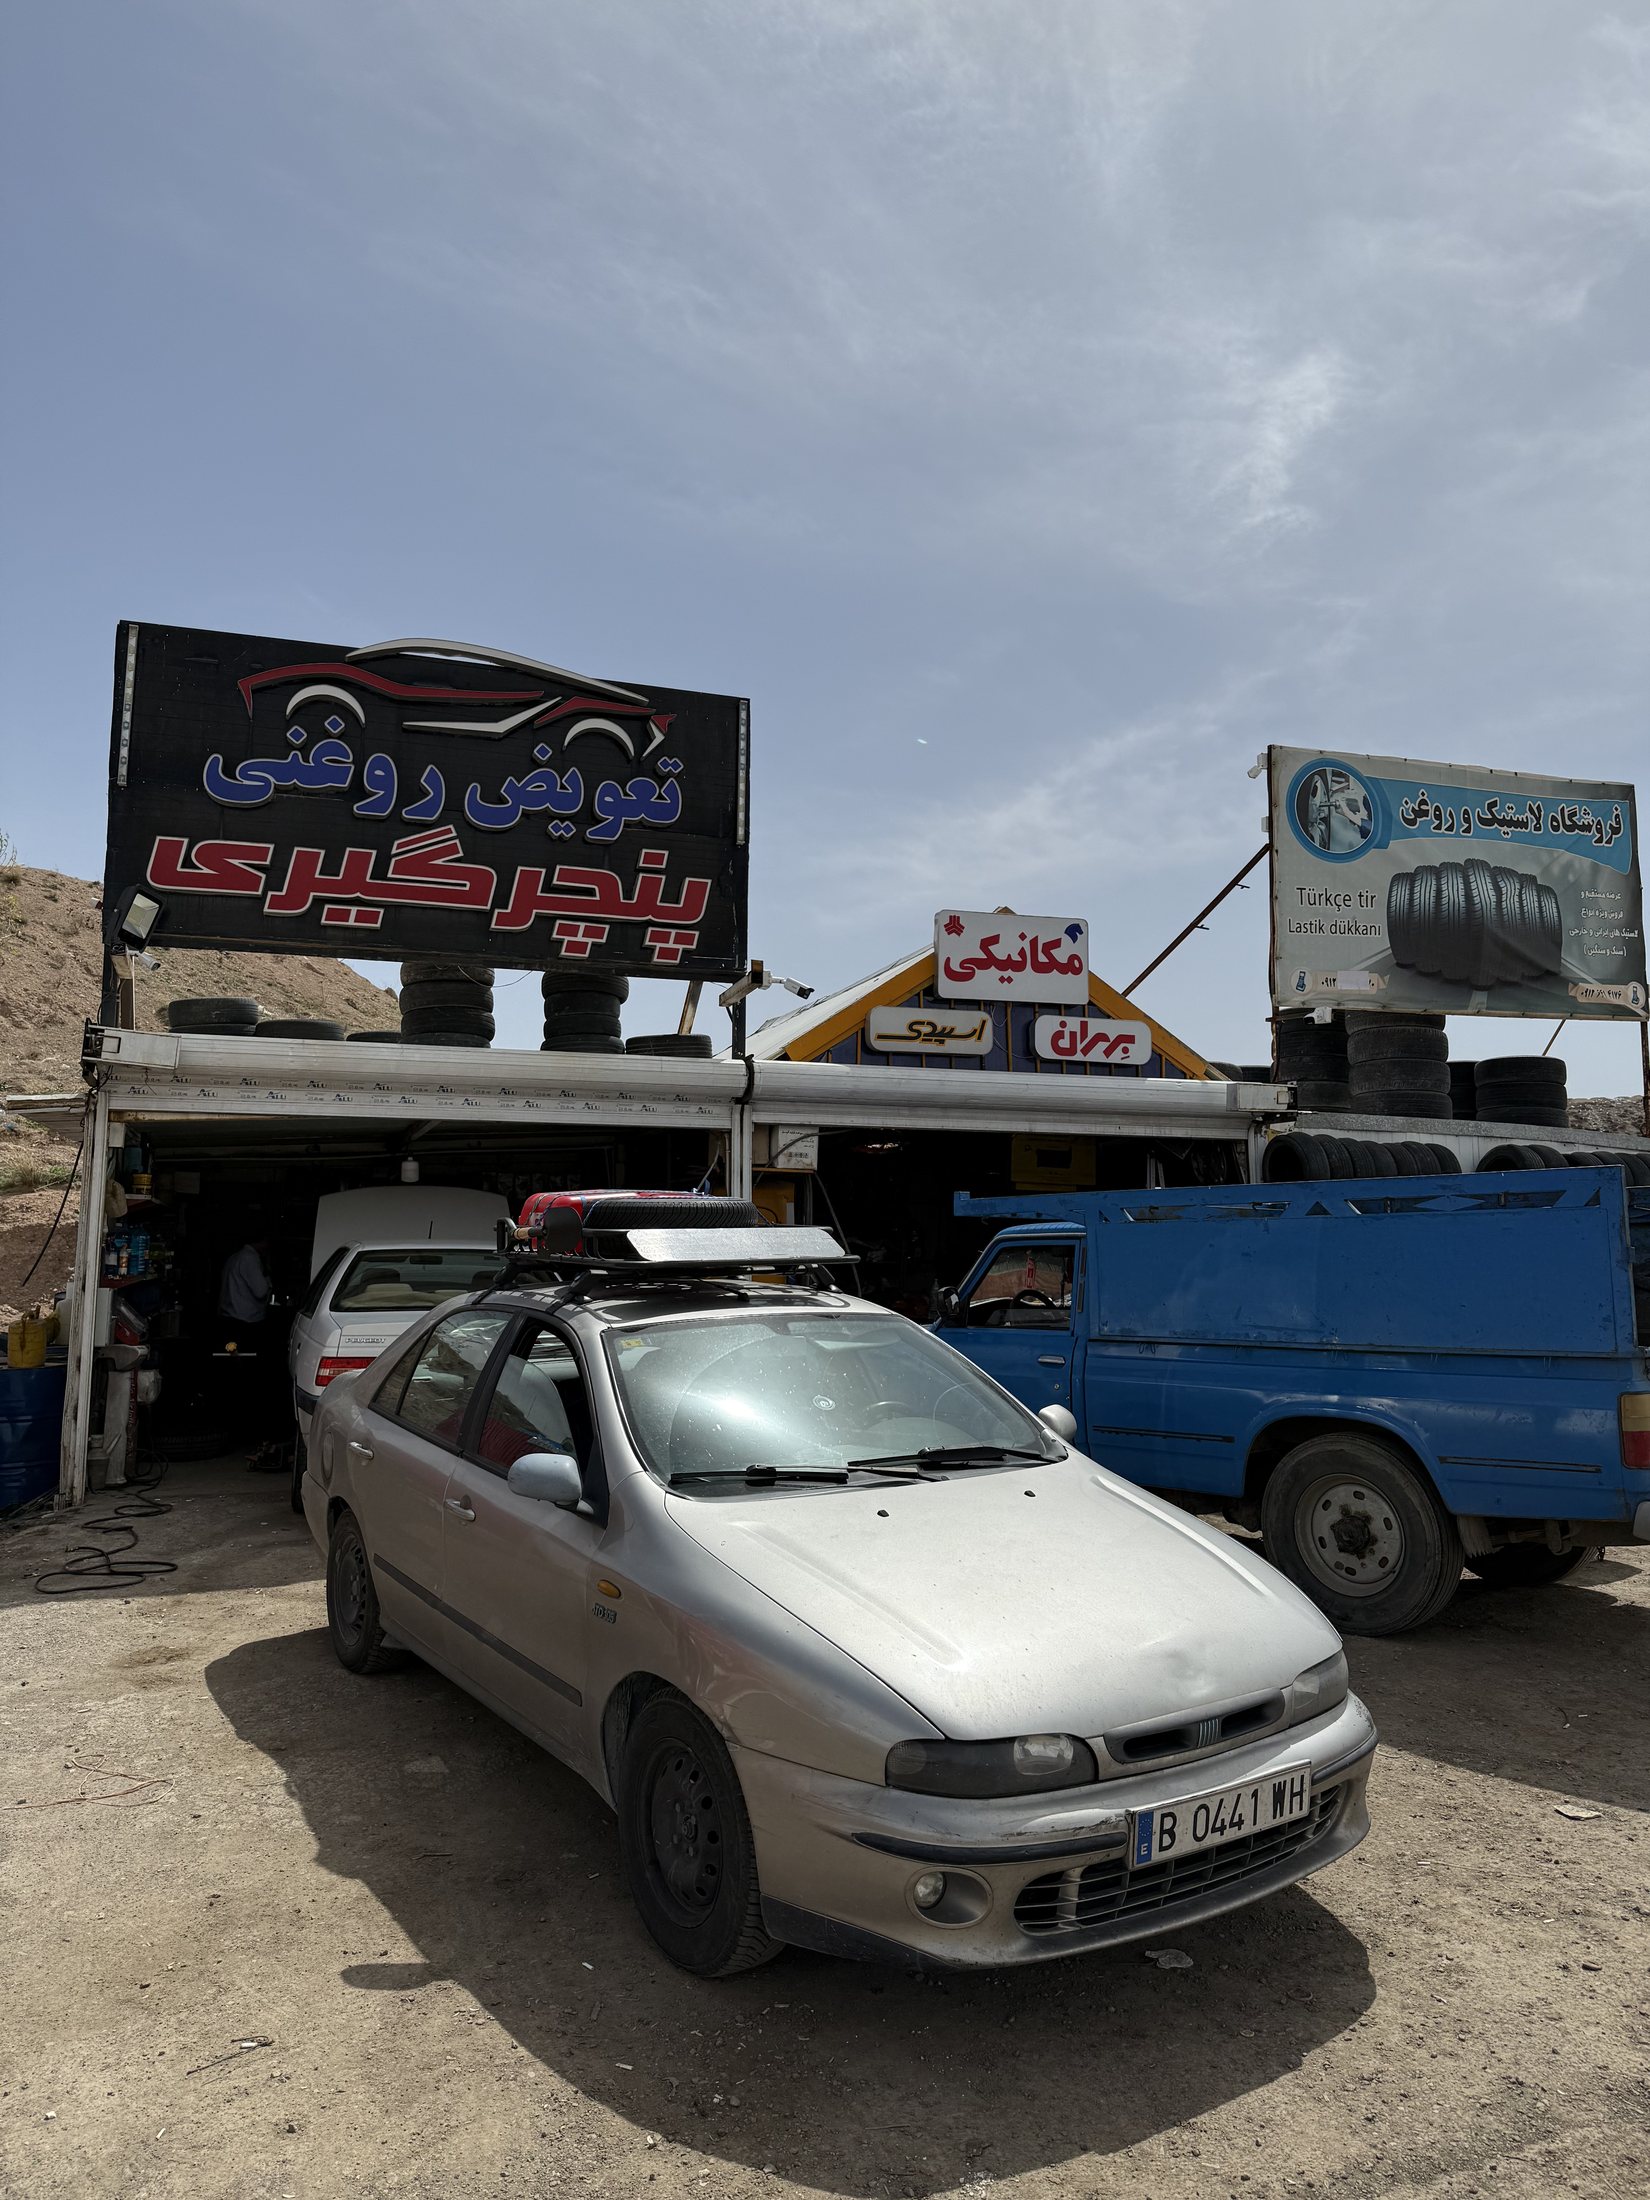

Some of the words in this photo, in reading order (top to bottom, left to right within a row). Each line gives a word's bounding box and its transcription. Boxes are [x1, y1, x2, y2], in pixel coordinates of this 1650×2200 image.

[203, 716, 445, 823] روغنی
[465, 743, 683, 841] تعویض
[1400, 789, 1455, 833] روغن
[1460, 805, 1472, 835] و
[1476, 798, 1544, 838] لاستیک
[1549, 804, 1624, 846] فروشگاه
[1296, 887, 1352, 912] Türkçe
[1357, 890, 1377, 908] tir
[1608, 909, 1624, 919] فروش
[1288, 918, 1326, 935] Lastik
[1329, 919, 1381, 936] dükkanı
[1620, 928, 1639, 940] لاستیک
[943, 932, 1084, 985] مکانیکی
[1158, 1811, 1178, 1853] B
[1192, 1787, 1260, 1843] 0441
[1272, 1774, 1305, 1820] WH
[1140, 1843, 1149, 1855] E
